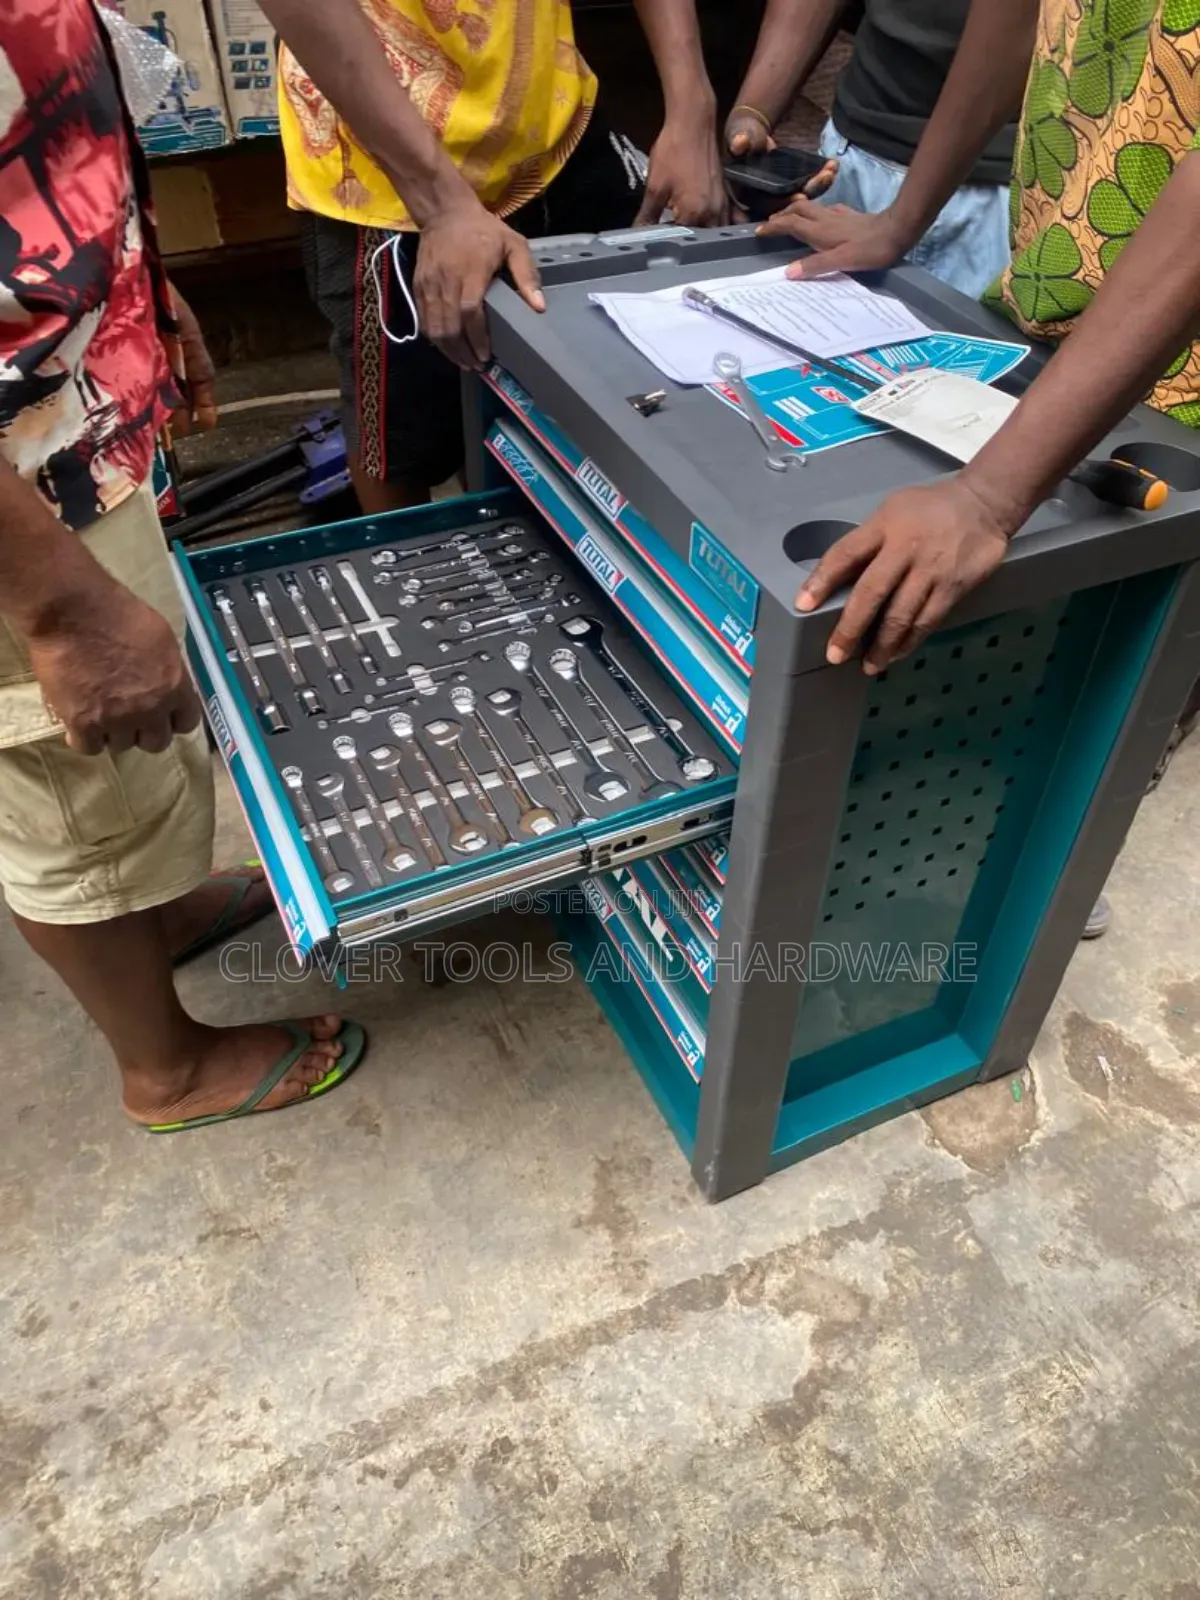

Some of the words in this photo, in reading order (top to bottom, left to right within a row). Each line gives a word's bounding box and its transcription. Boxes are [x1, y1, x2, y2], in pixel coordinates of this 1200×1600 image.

[581, 462, 618, 508] TOTAL
[581, 541, 615, 586] TOTAL
[699, 536, 748, 602] TOTAL
